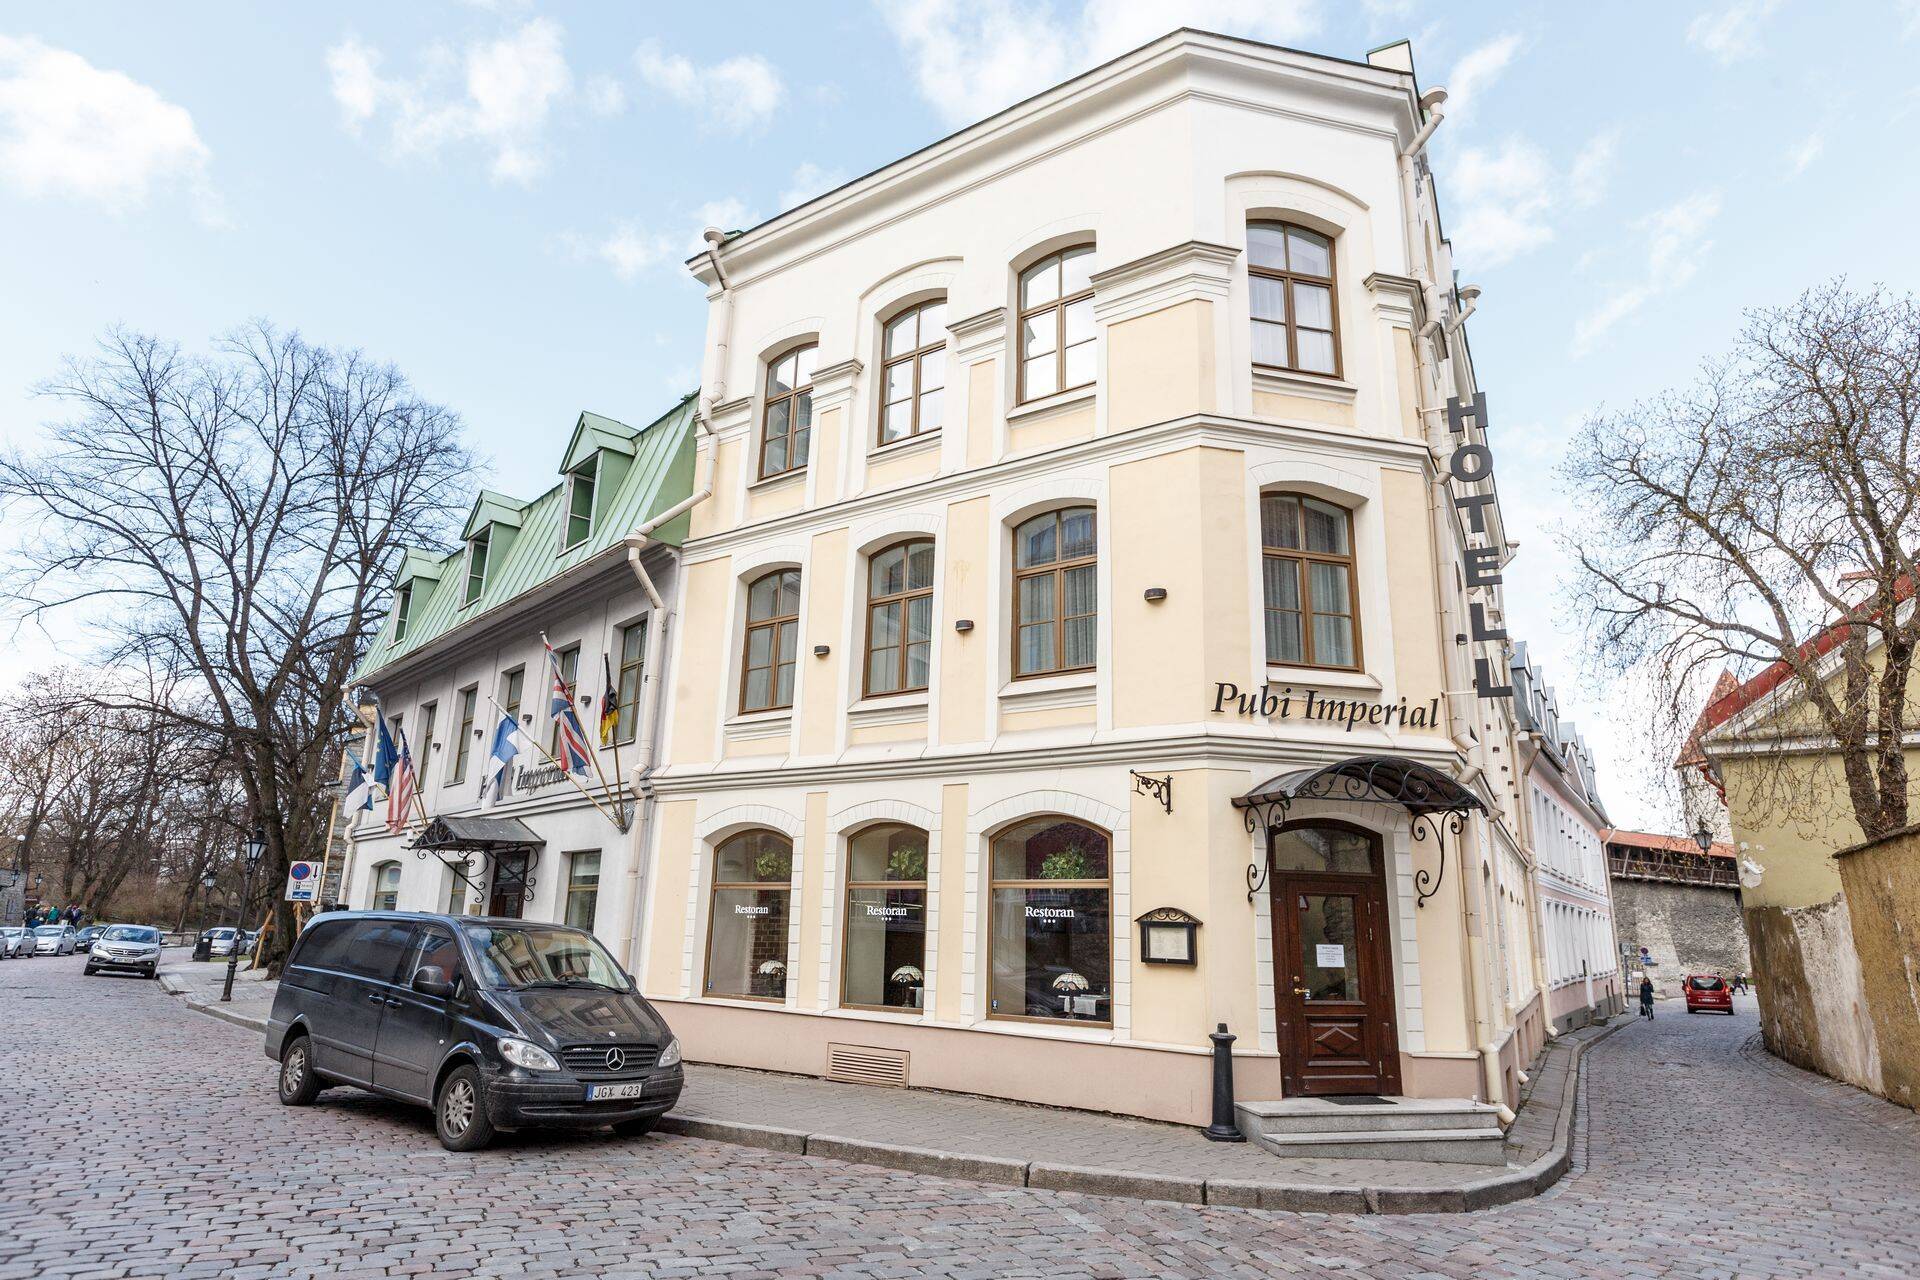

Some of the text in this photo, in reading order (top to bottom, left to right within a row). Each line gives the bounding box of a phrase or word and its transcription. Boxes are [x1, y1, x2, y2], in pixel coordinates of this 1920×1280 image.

[1447, 391, 1513, 698] HOTELL
[1211, 682, 1439, 732] Pubi Imperial
[735, 904, 769, 915] Restoran
[866, 905, 908, 916] Restoran
[1024, 906, 1075, 918] Restoran
[594, 1085, 639, 1099] JGX 423
